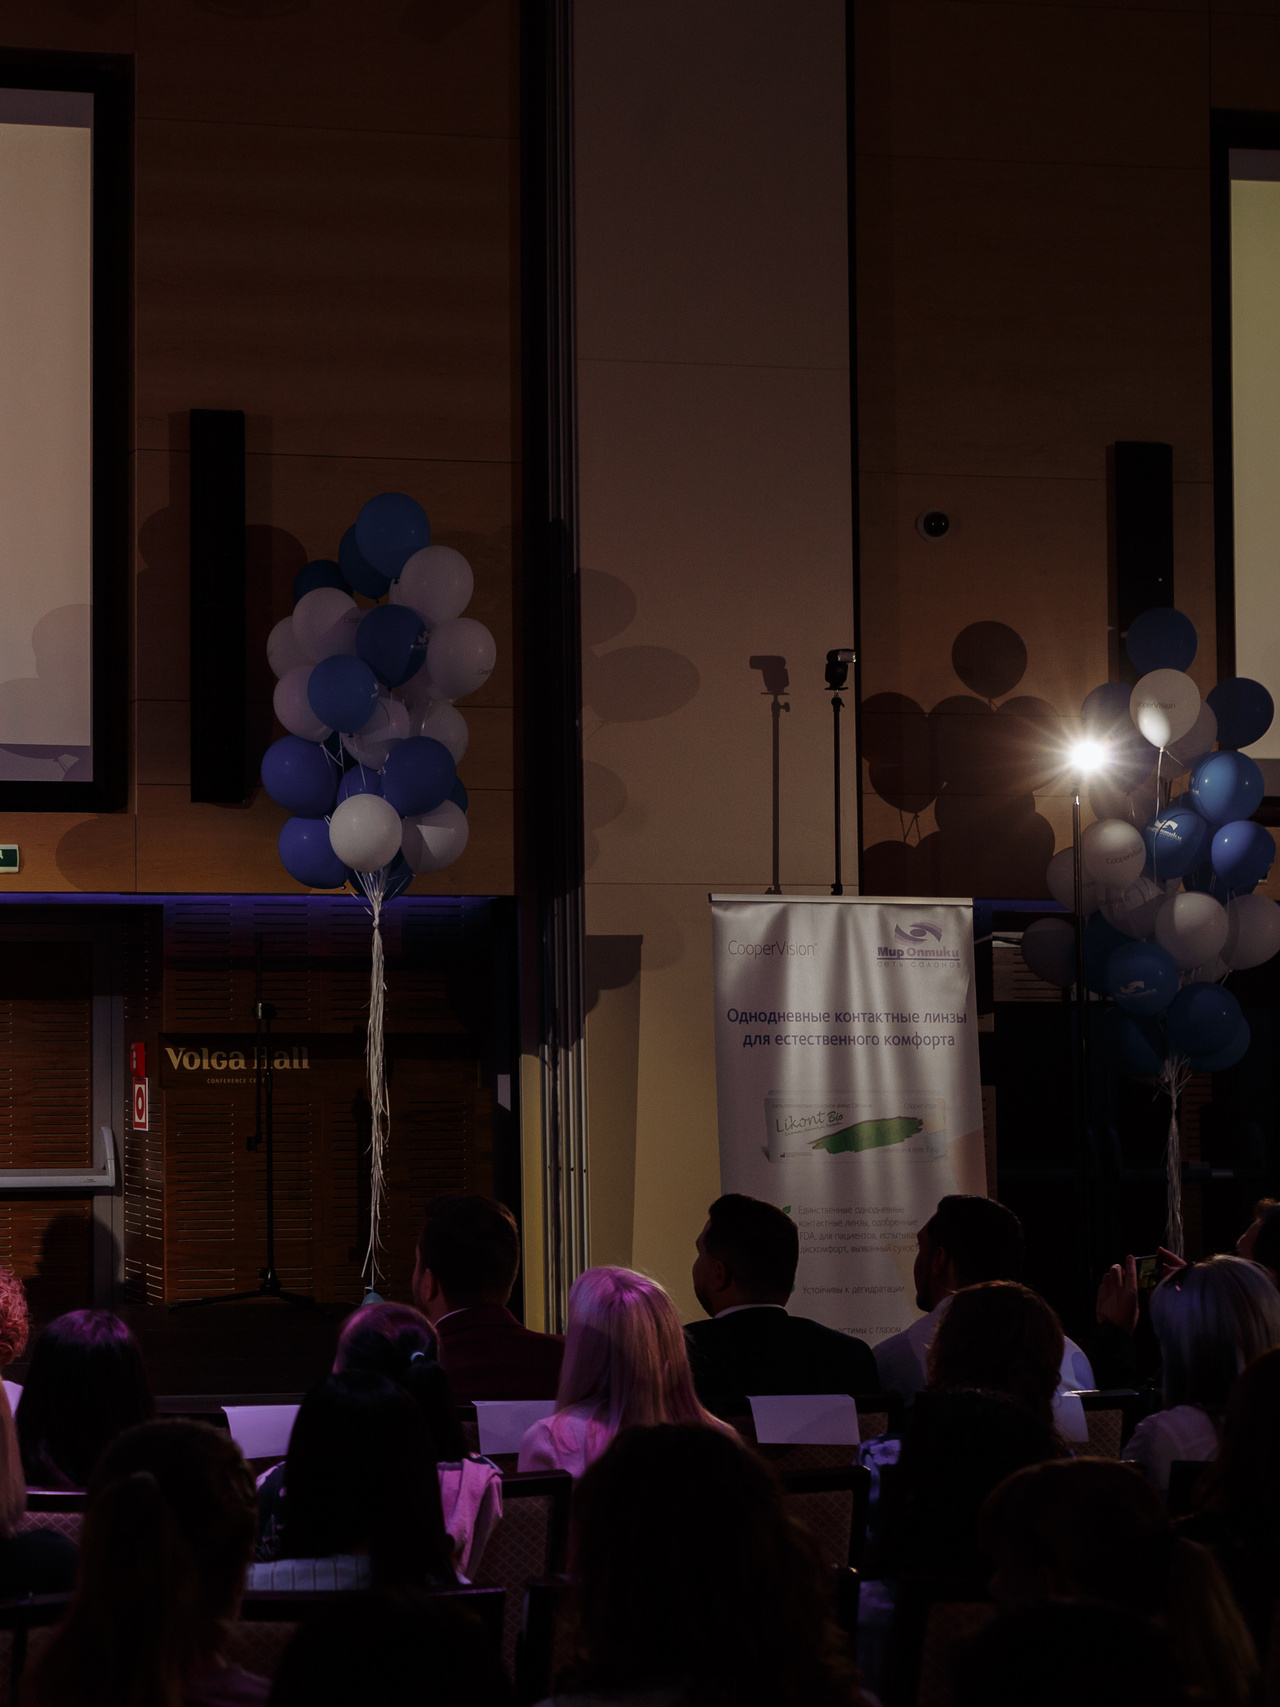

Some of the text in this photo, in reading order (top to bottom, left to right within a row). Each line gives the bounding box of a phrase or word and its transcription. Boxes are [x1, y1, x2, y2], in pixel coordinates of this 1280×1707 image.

[727, 940, 815, 959] CooperVision
[727, 1008, 967, 1024] Однодневные контактные линзы
[743, 1031, 955, 1049] для естественного комфорта
[165, 1047, 247, 1070] Volga
[776, 1111, 825, 1133] Likont
[827, 1110, 844, 1123] Bio
[798, 1206, 853, 1215] Единственные
[799, 1220, 843, 1228] контактные
[802, 1284, 842, 1295] Устойчивы
[852, 1285, 905, 1295] дегидратации
[876, 1326, 902, 1334] глазом
